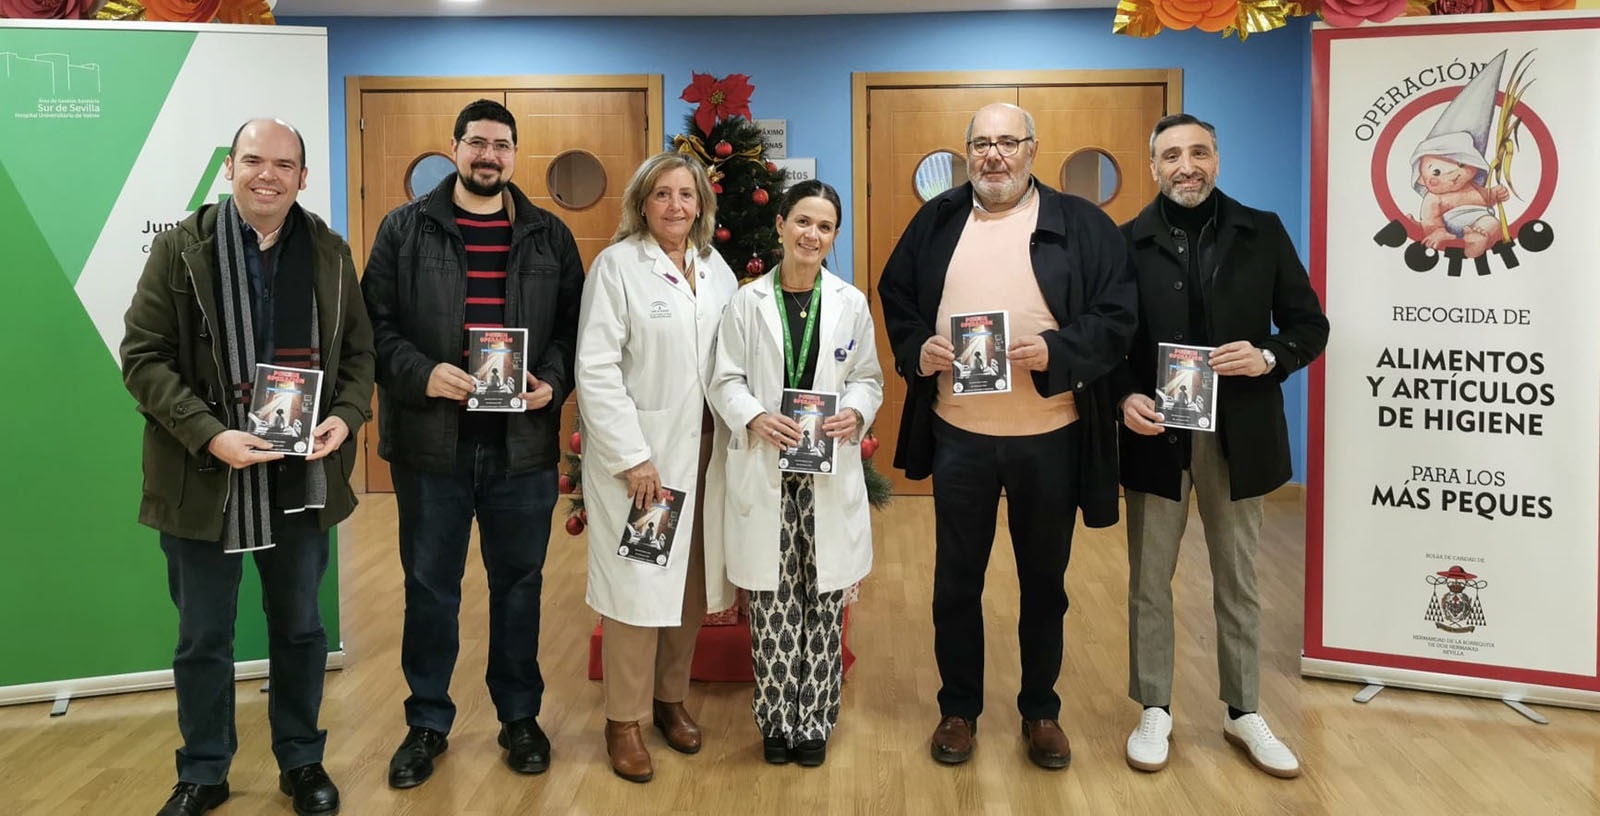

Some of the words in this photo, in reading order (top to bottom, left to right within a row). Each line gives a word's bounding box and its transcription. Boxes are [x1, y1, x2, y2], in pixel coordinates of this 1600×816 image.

[38, 103, 53, 112] Sur
[55, 103, 68, 112] de
[69, 103, 100, 112] Sevilla
[1355, 57, 1490, 142] OPERACIÓN
[785, 170, 808, 180] ctos
[1373, 218, 1554, 277] POTITO
[1392, 306, 1498, 324] RECOGIDA
[1503, 308, 1531, 325] DE
[1376, 347, 1545, 375] ALIMENTOS
[1366, 375, 1386, 398] Y
[1391, 372, 1555, 406] ARTÍCULOS
[1378, 405, 1413, 429] DE
[1424, 408, 1543, 436] HIGIENE
[1411, 465, 1461, 484] PARA
[1466, 468, 1506, 487] LOS
[1371, 479, 1431, 510] MÁS
[1441, 489, 1554, 521] PEQUES
